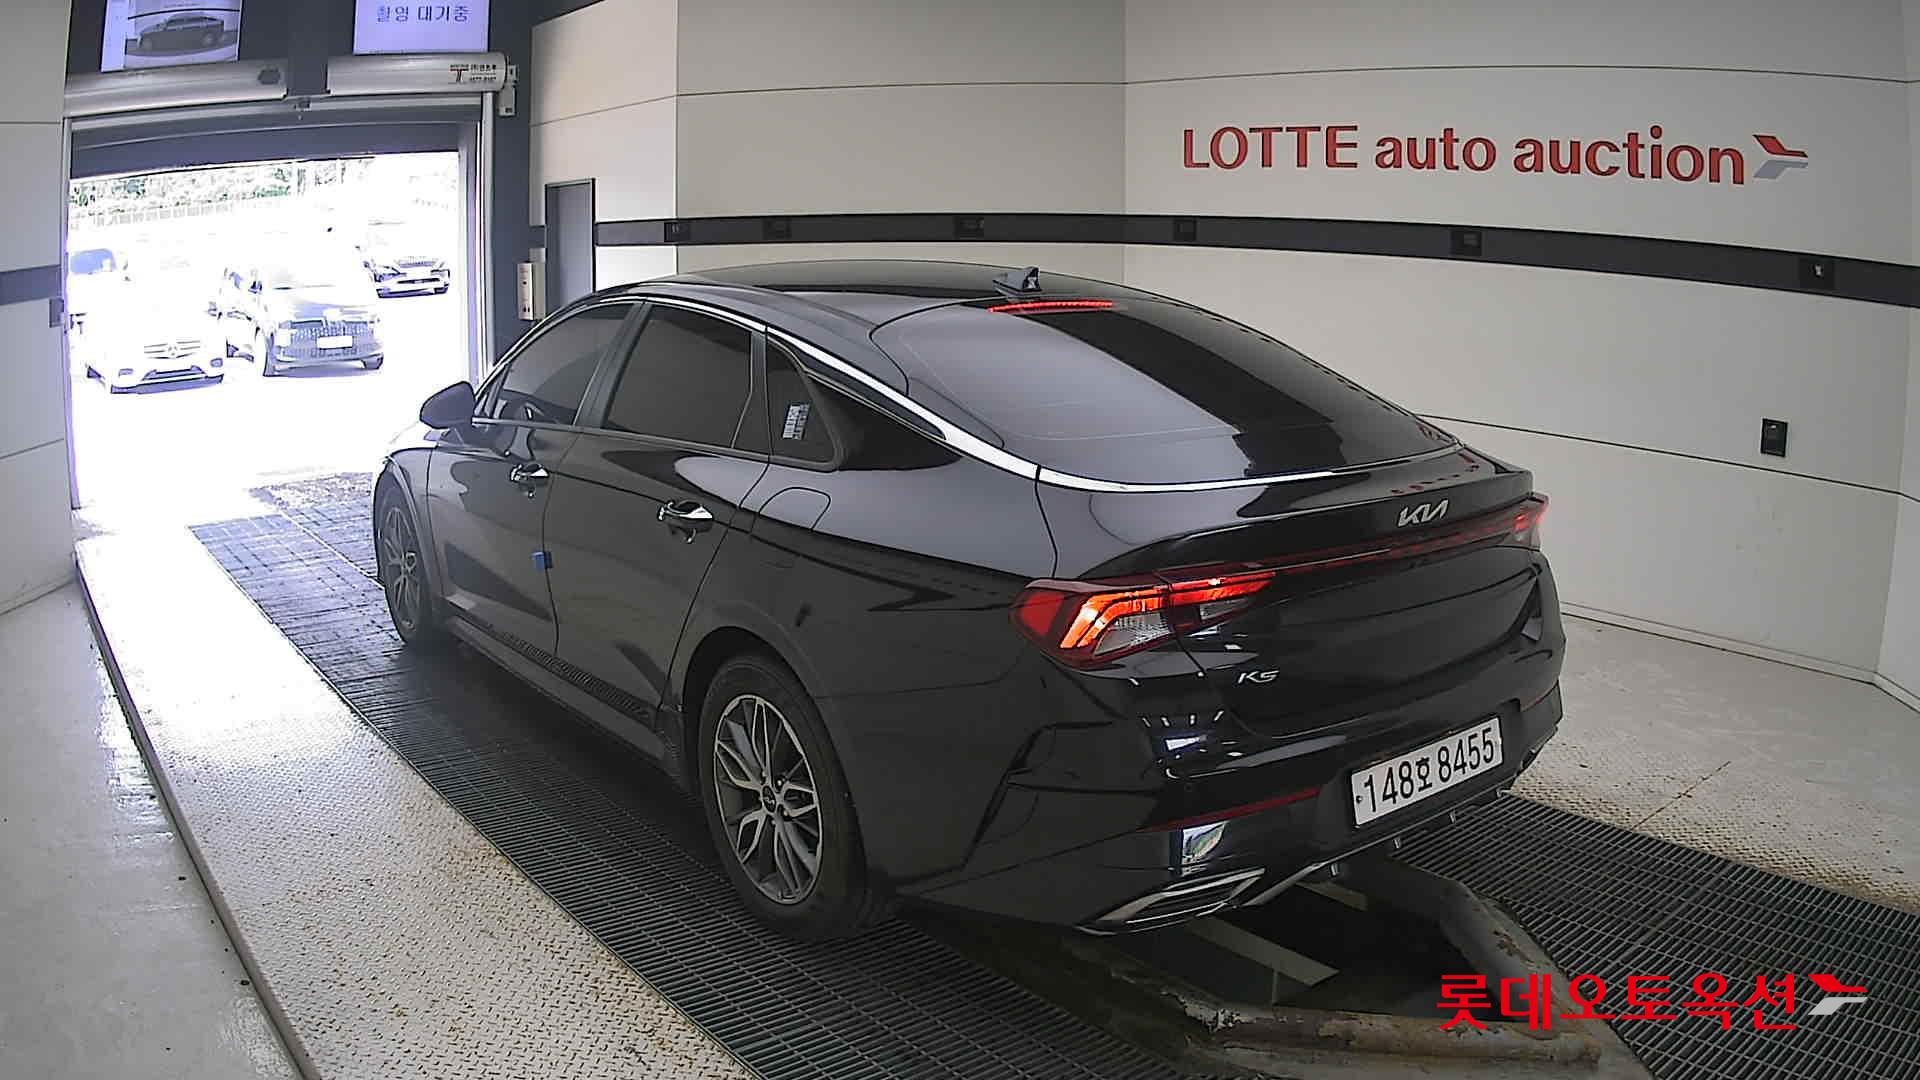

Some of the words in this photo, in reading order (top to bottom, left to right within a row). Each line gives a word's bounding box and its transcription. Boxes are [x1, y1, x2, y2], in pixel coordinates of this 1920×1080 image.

[417, 5, 470, 22] 대기중
[1183, 125, 1358, 169] LOTTE
[1376, 127, 1497, 172] auto
[1513, 124, 1745, 185] auction
[1397, 499, 1450, 528] KIA
[1236, 669, 1281, 685] K5
